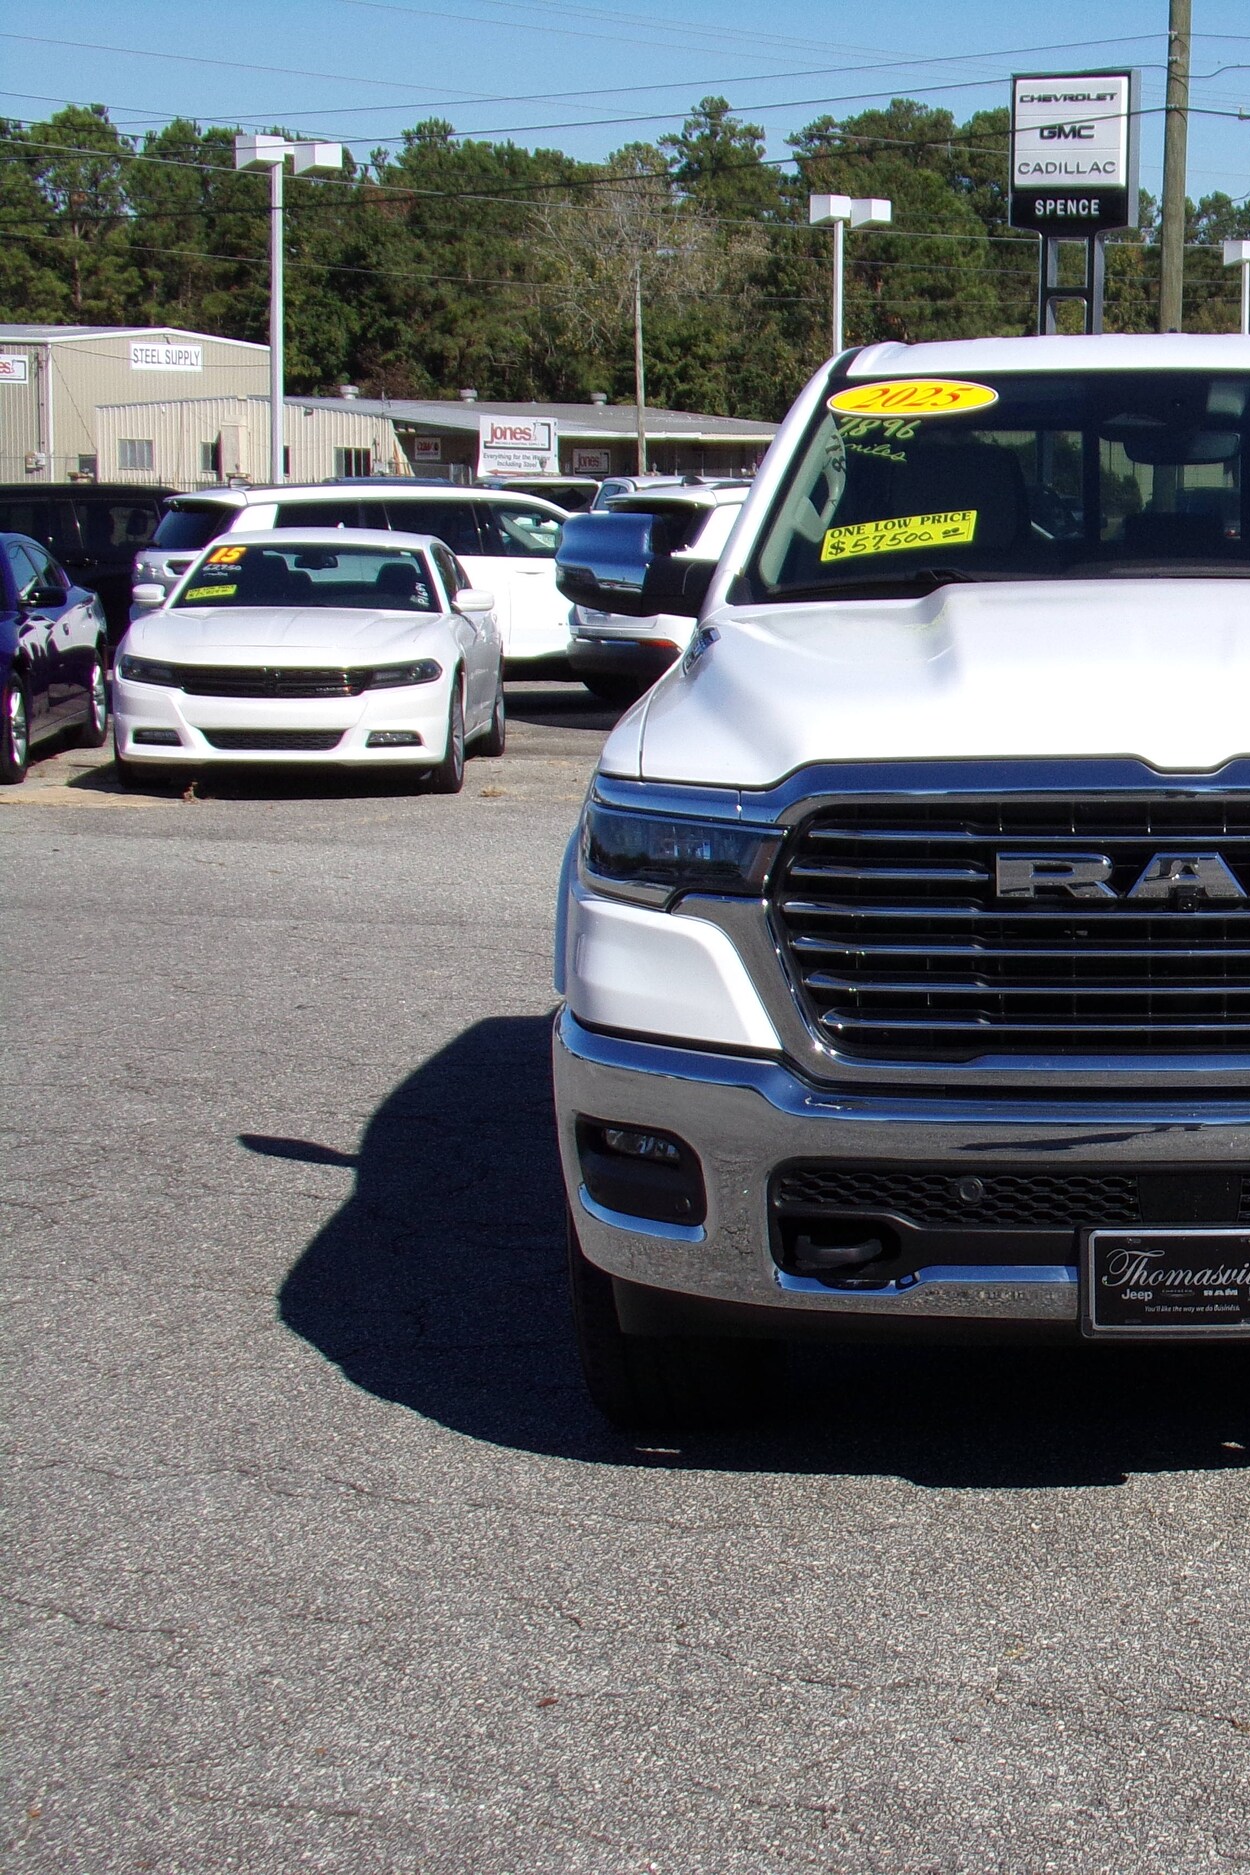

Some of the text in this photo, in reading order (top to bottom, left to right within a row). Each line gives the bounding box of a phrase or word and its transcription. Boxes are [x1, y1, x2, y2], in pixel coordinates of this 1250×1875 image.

[1019, 92, 1117, 103] CHEVROLET
[1039, 124, 1095, 139] GMC
[1017, 161, 1116, 175] CADILLAC
[1035, 199, 1099, 215] SPENCE
[133, 348, 200, 367] STEEL SUPPLY
[0, 361, 12, 374] es
[849, 386, 976, 409] 2025
[830, 511, 971, 539] ONE LOW PRICE
[206, 547, 247, 563] 15
[1121, 1288, 1153, 1301] Jeep
[1205, 1304, 1213, 1312] do
